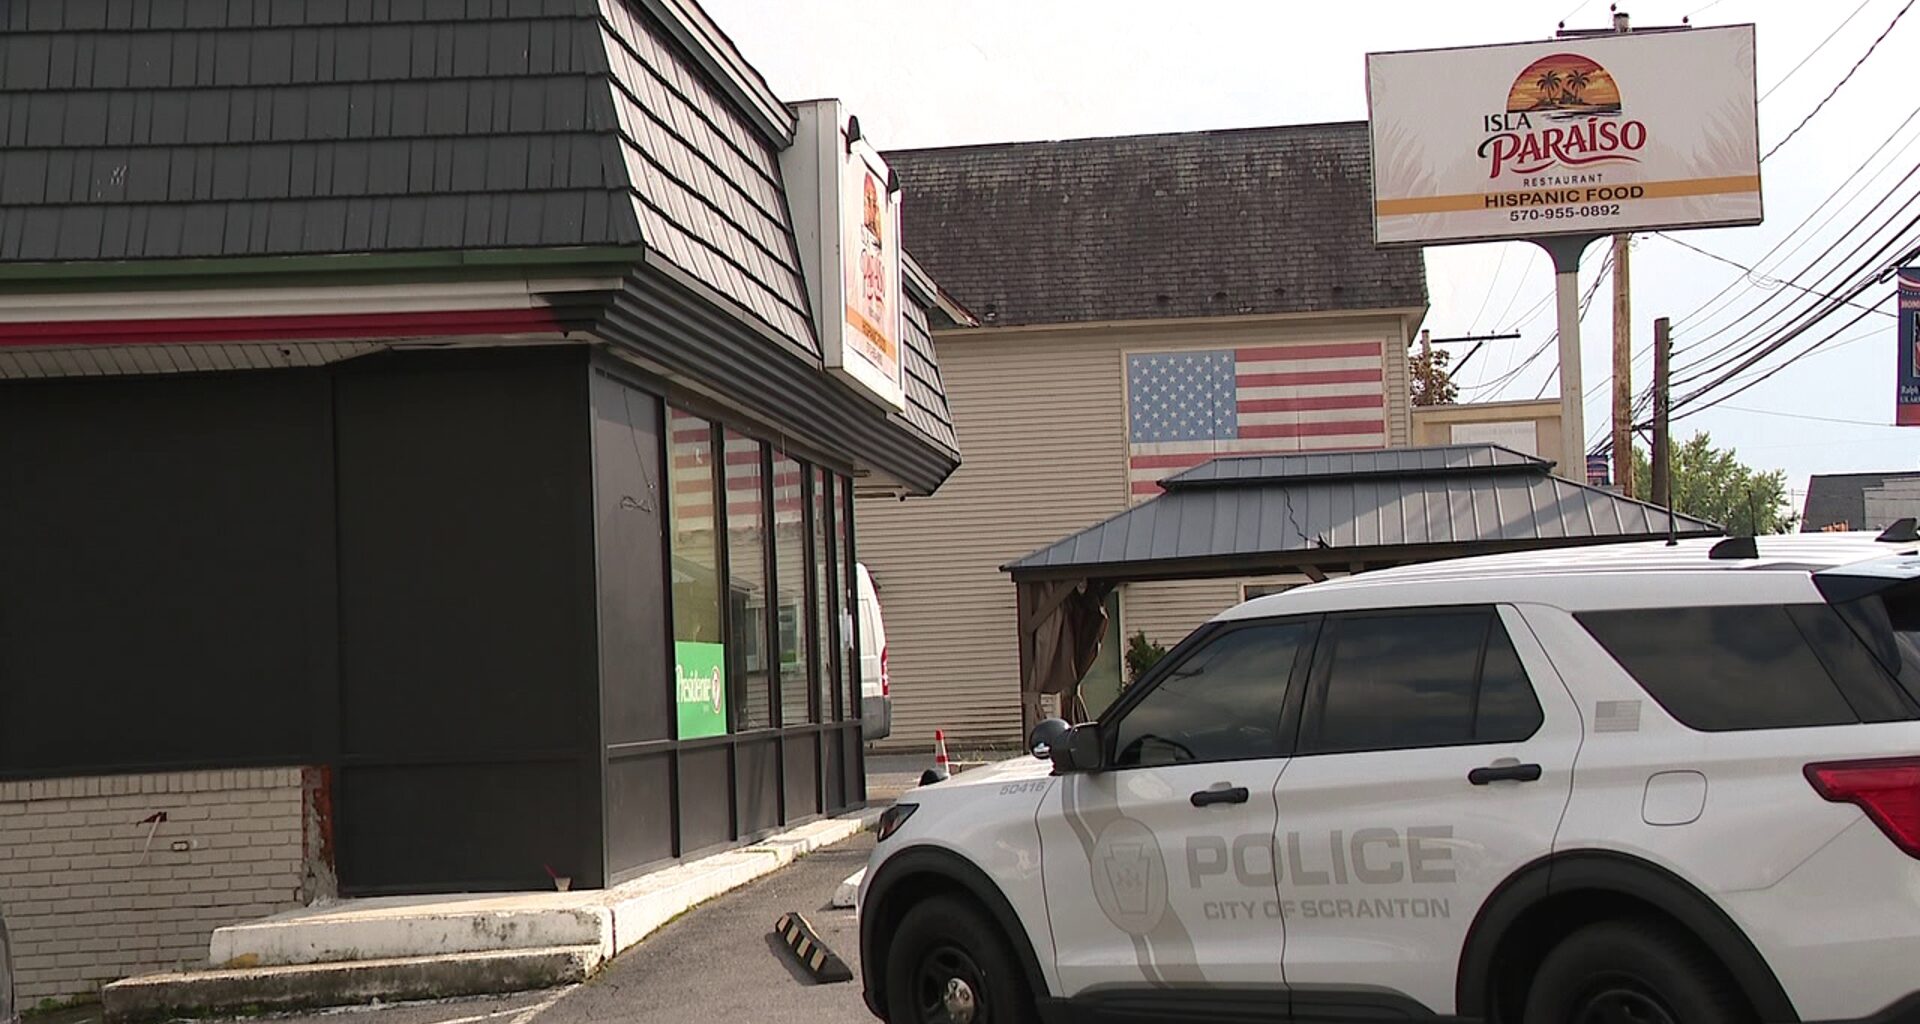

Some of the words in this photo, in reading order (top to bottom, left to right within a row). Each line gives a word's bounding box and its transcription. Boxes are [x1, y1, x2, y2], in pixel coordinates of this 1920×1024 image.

[1484, 112, 1532, 132] ISLA
[1477, 117, 1647, 178] PARAÍSO
[1523, 173, 1603, 188] RESTAURANT
[1485, 190, 1580, 208] HISPANIC
[1586, 185, 1644, 202] FOOD
[1510, 203, 1620, 222] 570-955-0892
[1185, 825, 1457, 889] POLICE
[1203, 900, 1256, 921] CITY
[1263, 900, 1296, 920] OF
[1302, 898, 1451, 920] SCRANTON
